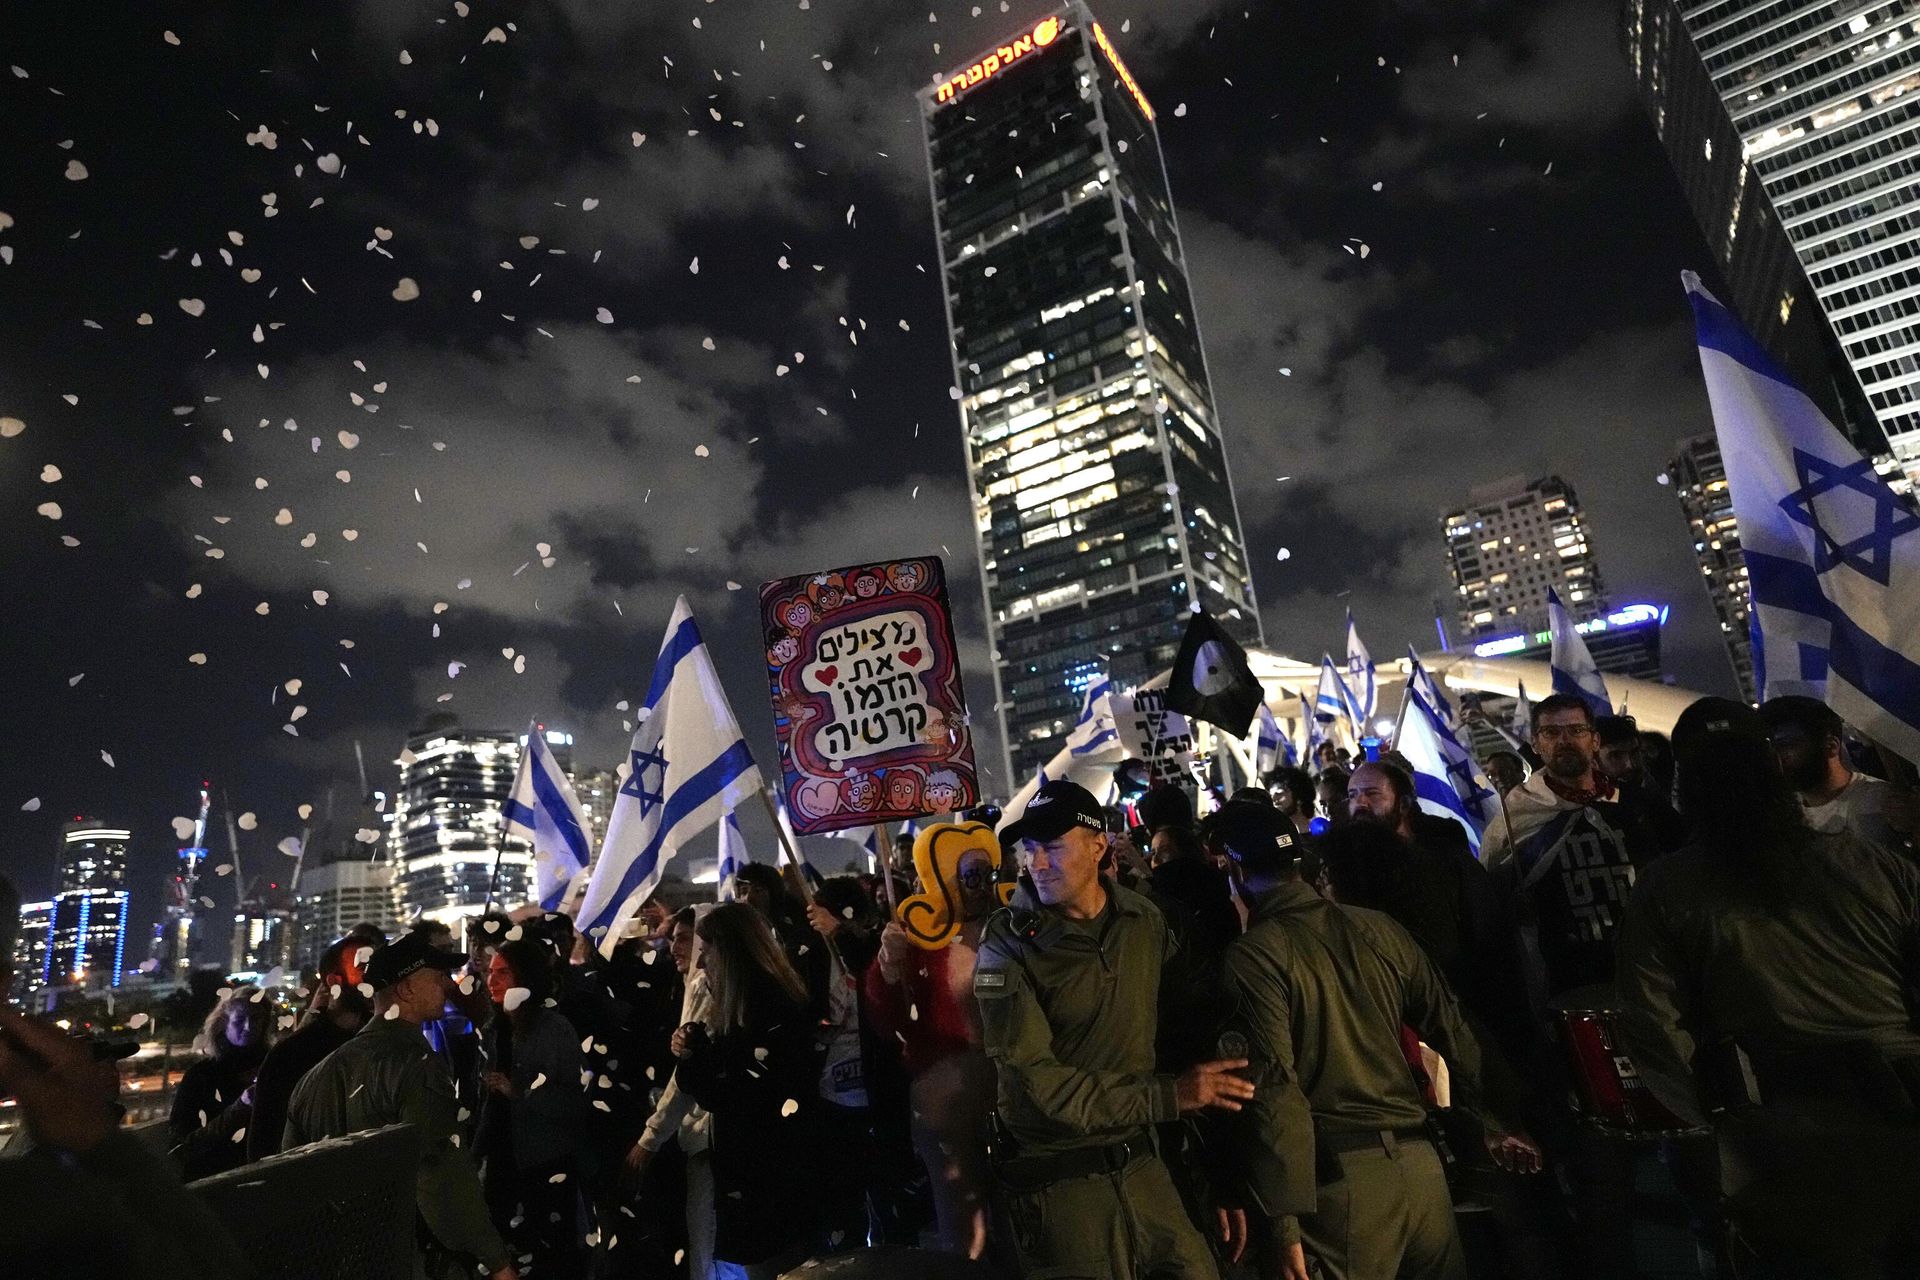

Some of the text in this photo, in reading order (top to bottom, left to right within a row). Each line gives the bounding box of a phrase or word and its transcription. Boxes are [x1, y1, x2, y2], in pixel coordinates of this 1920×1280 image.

[937, 34, 1033, 103] אלקטרה
[818, 620, 917, 663] מצילים
[848, 653, 895, 683] את
[824, 702, 928, 755] קרטיה
[1077, 812, 1102, 829] משטרה
[397, 958, 426, 978] POLICE
